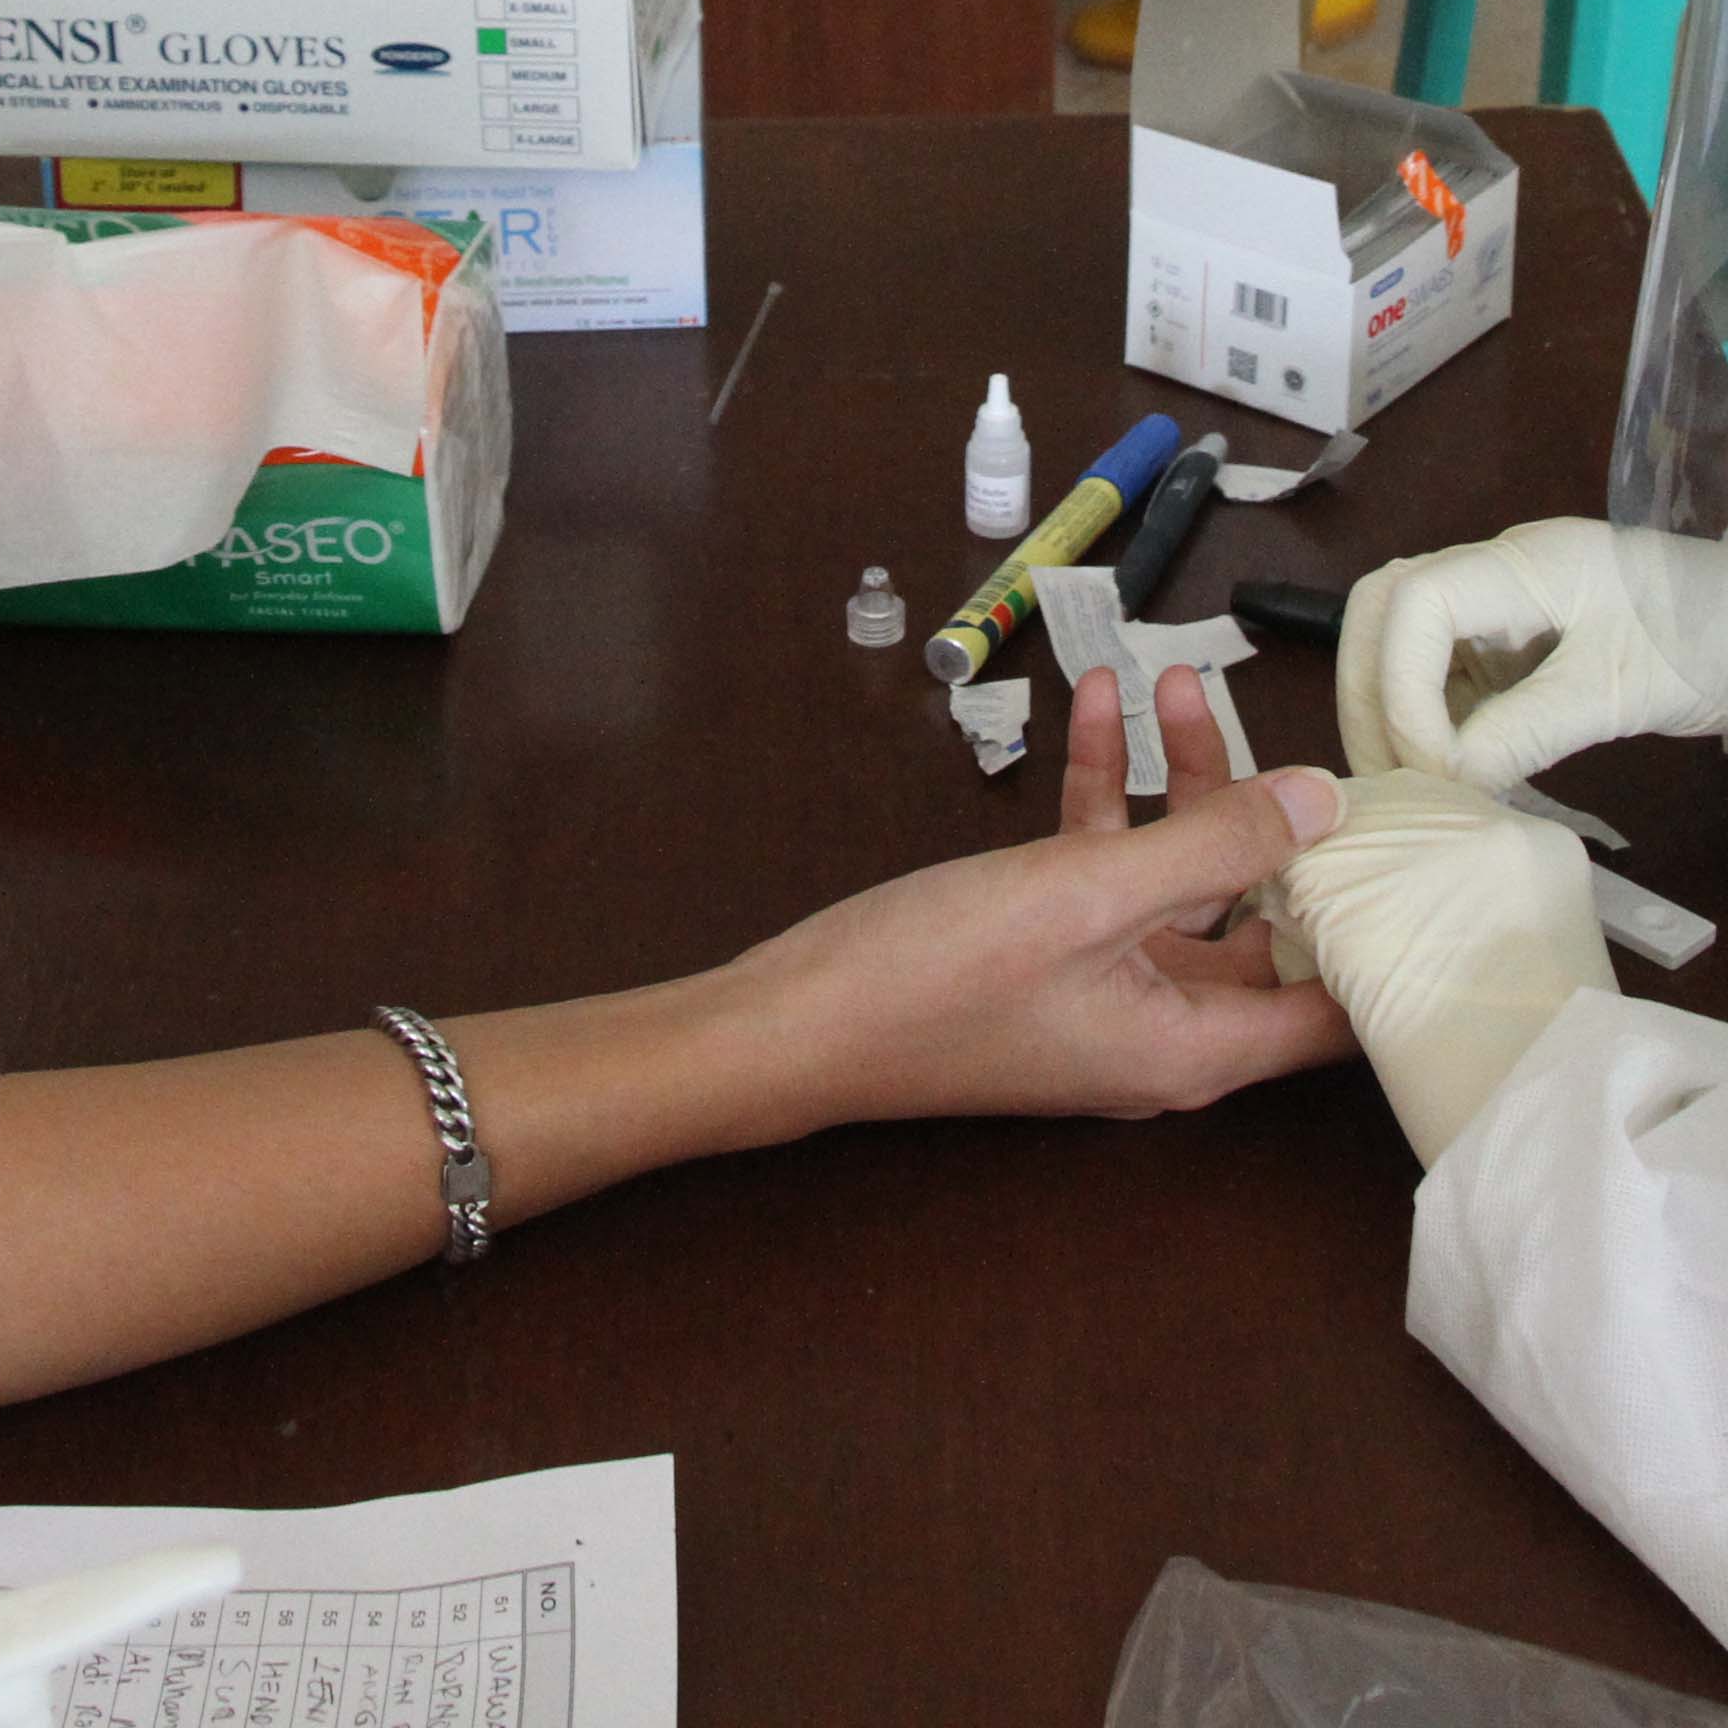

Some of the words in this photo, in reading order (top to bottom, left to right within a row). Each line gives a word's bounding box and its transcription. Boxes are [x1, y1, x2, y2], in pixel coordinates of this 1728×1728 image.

[158, 32, 347, 68] GLOVES
[510, 37, 557, 49] SMALL
[511, 70, 567, 82] MEDIUM
[48, 74, 111, 91] LATEX
[118, 75, 258, 95] EXAMINATION
[262, 79, 349, 97] GLOVES
[513, 102, 560, 114] LARGE
[185, 516, 393, 568] ASEO
[254, 571, 333, 586] Smart
[494, 1596, 509, 1614] 51
[541, 1582, 557, 1618] NO.
[190, 1610, 206, 1627] 58
[235, 1611, 251, 1627] 57
[278, 1610, 294, 1626] 56
[322, 1610, 338, 1626] 55
[367, 1611, 382, 1627] 54
[411, 1610, 426, 1628] 53
[452, 1603, 467, 1623] 52
